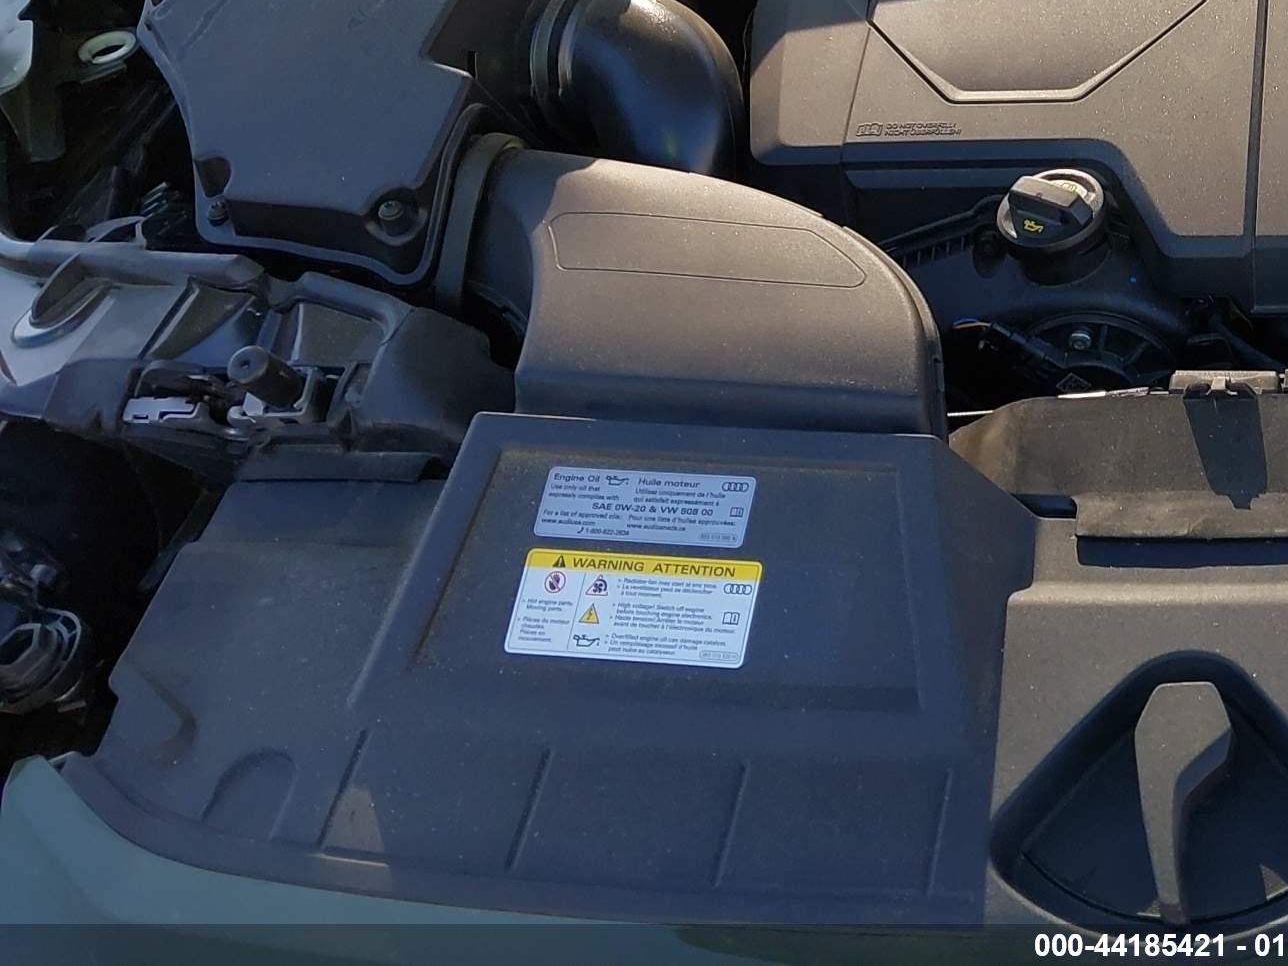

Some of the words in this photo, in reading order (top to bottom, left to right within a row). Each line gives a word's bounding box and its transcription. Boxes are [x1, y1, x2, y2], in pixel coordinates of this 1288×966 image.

[554, 473, 585, 483] Engine
[587, 474, 601, 483] Oil
[638, 478, 662, 487] Huile
[664, 480, 701, 488] moteur
[592, 502, 613, 511] SAE
[614, 503, 647, 513] 0W-20
[648, 505, 657, 513] &
[660, 505, 679, 514] VW
[701, 508, 714, 516] 00
[572, 558, 645, 572] WARNING
[652, 563, 737, 578] ATTENTION
